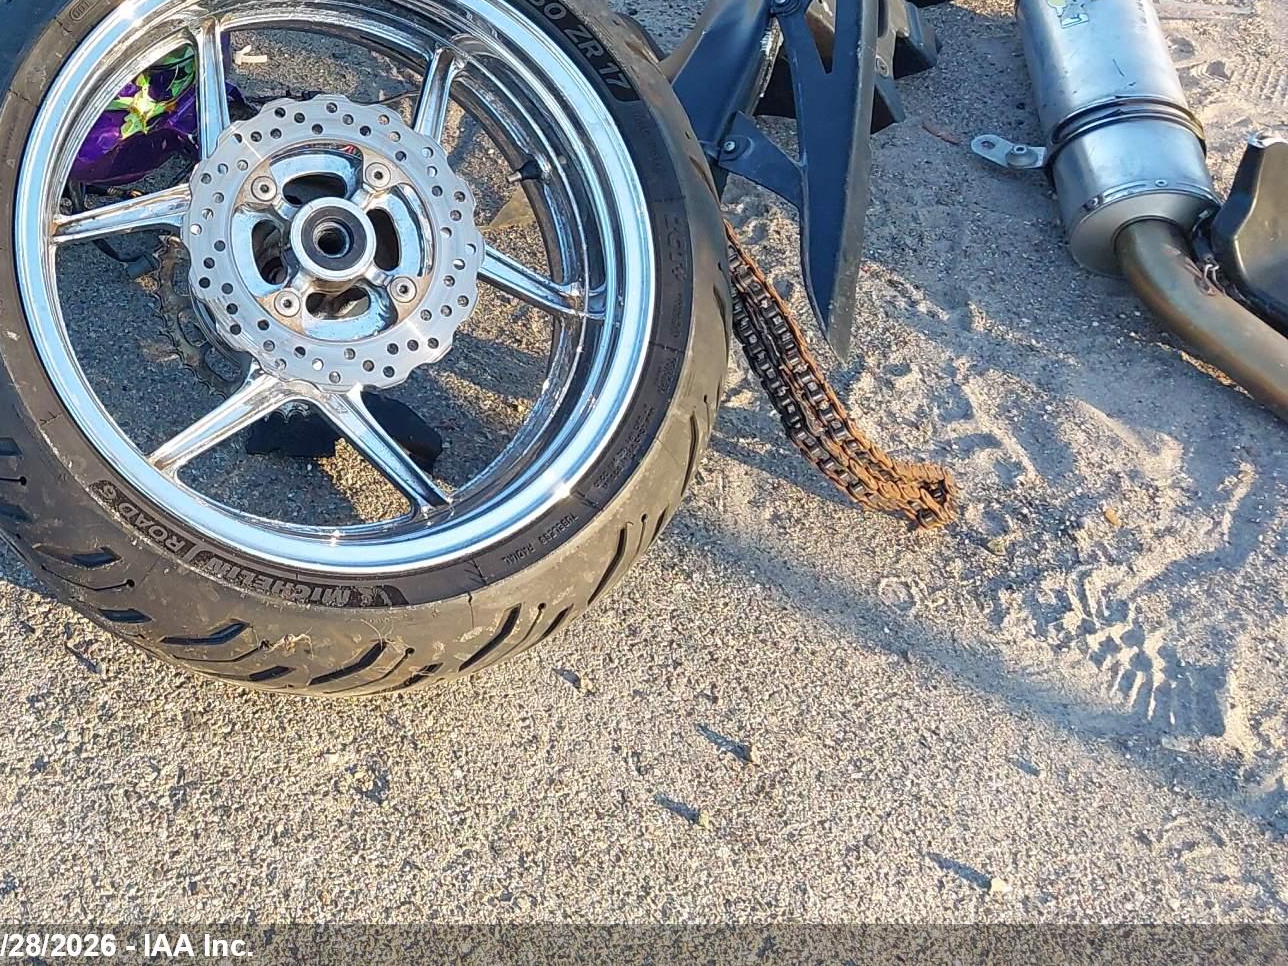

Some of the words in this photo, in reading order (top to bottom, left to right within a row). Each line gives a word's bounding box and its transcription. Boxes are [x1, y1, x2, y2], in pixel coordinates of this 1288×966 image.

[564, 24, 605, 59] ZR
[598, 62, 631, 89] 17
[117, 501, 186, 553] ROAD
[208, 556, 351, 607] MICHELIN
